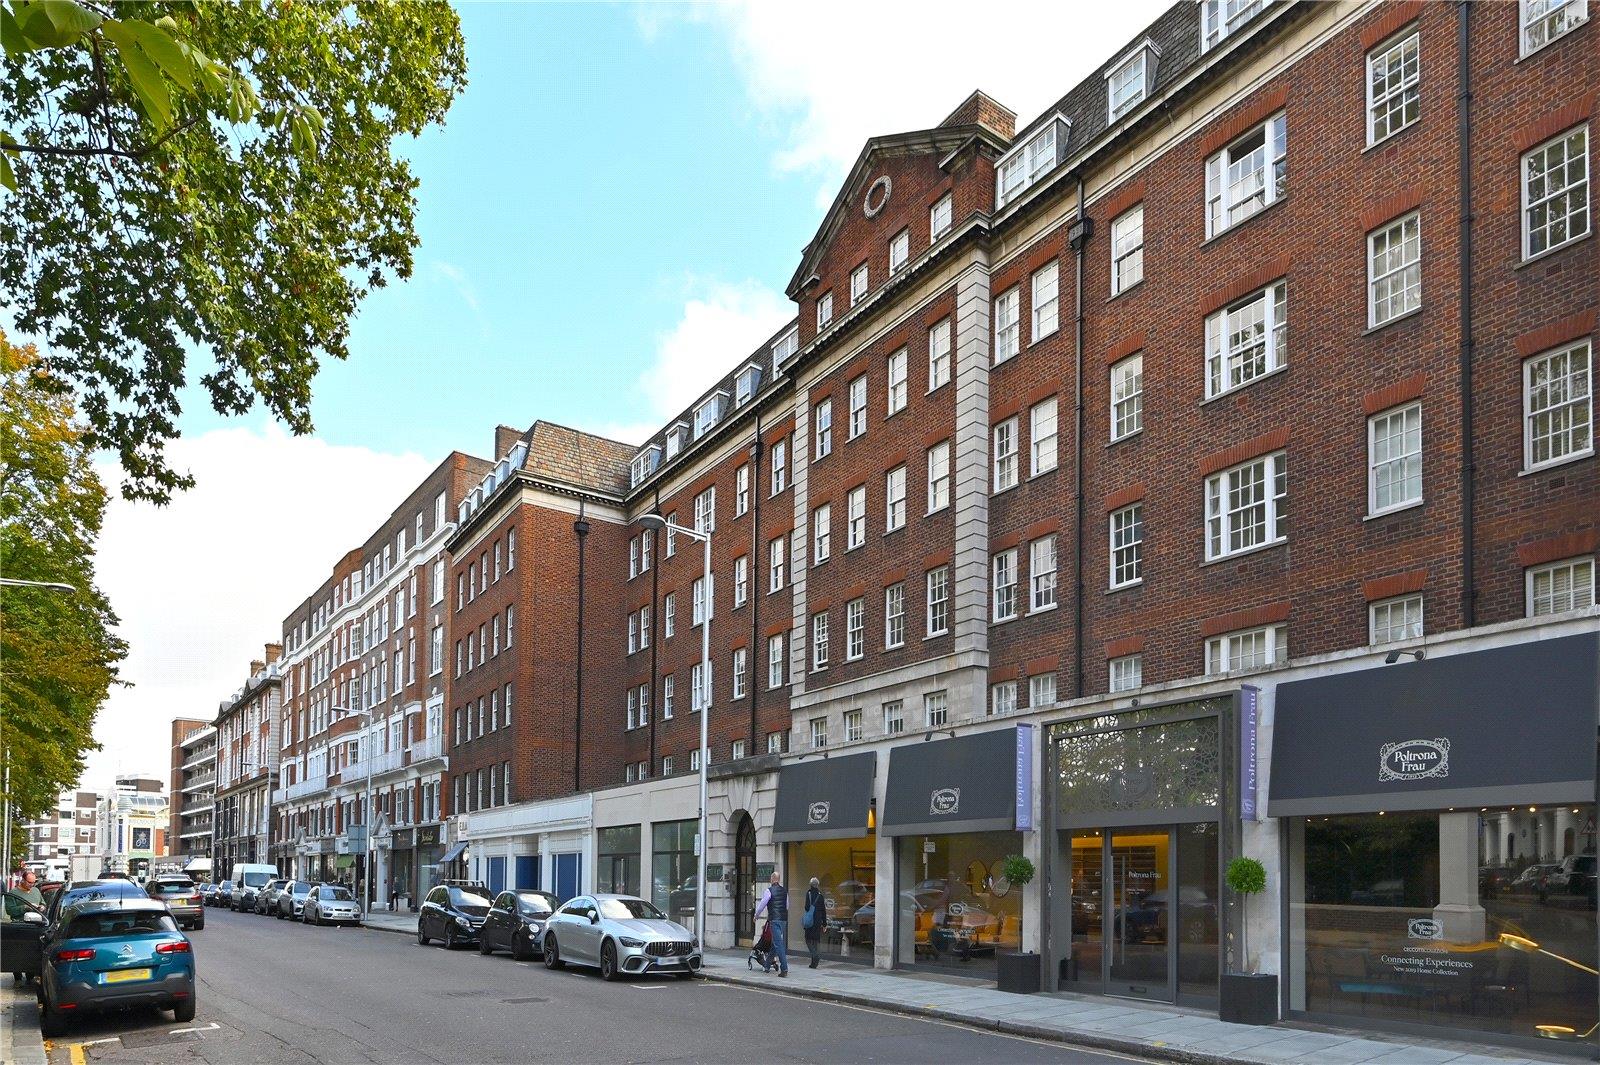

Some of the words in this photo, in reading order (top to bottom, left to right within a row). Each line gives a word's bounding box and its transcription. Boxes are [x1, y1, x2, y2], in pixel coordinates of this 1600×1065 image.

[1395, 750, 1437, 762] Poltrona
[1402, 762, 1426, 772] Frau
[1415, 923, 1438, 932] Poltrona
[1380, 954, 1424, 967] Connecting
[1426, 957, 1474, 969] Experiences
[1432, 968, 1459, 976] Collection
